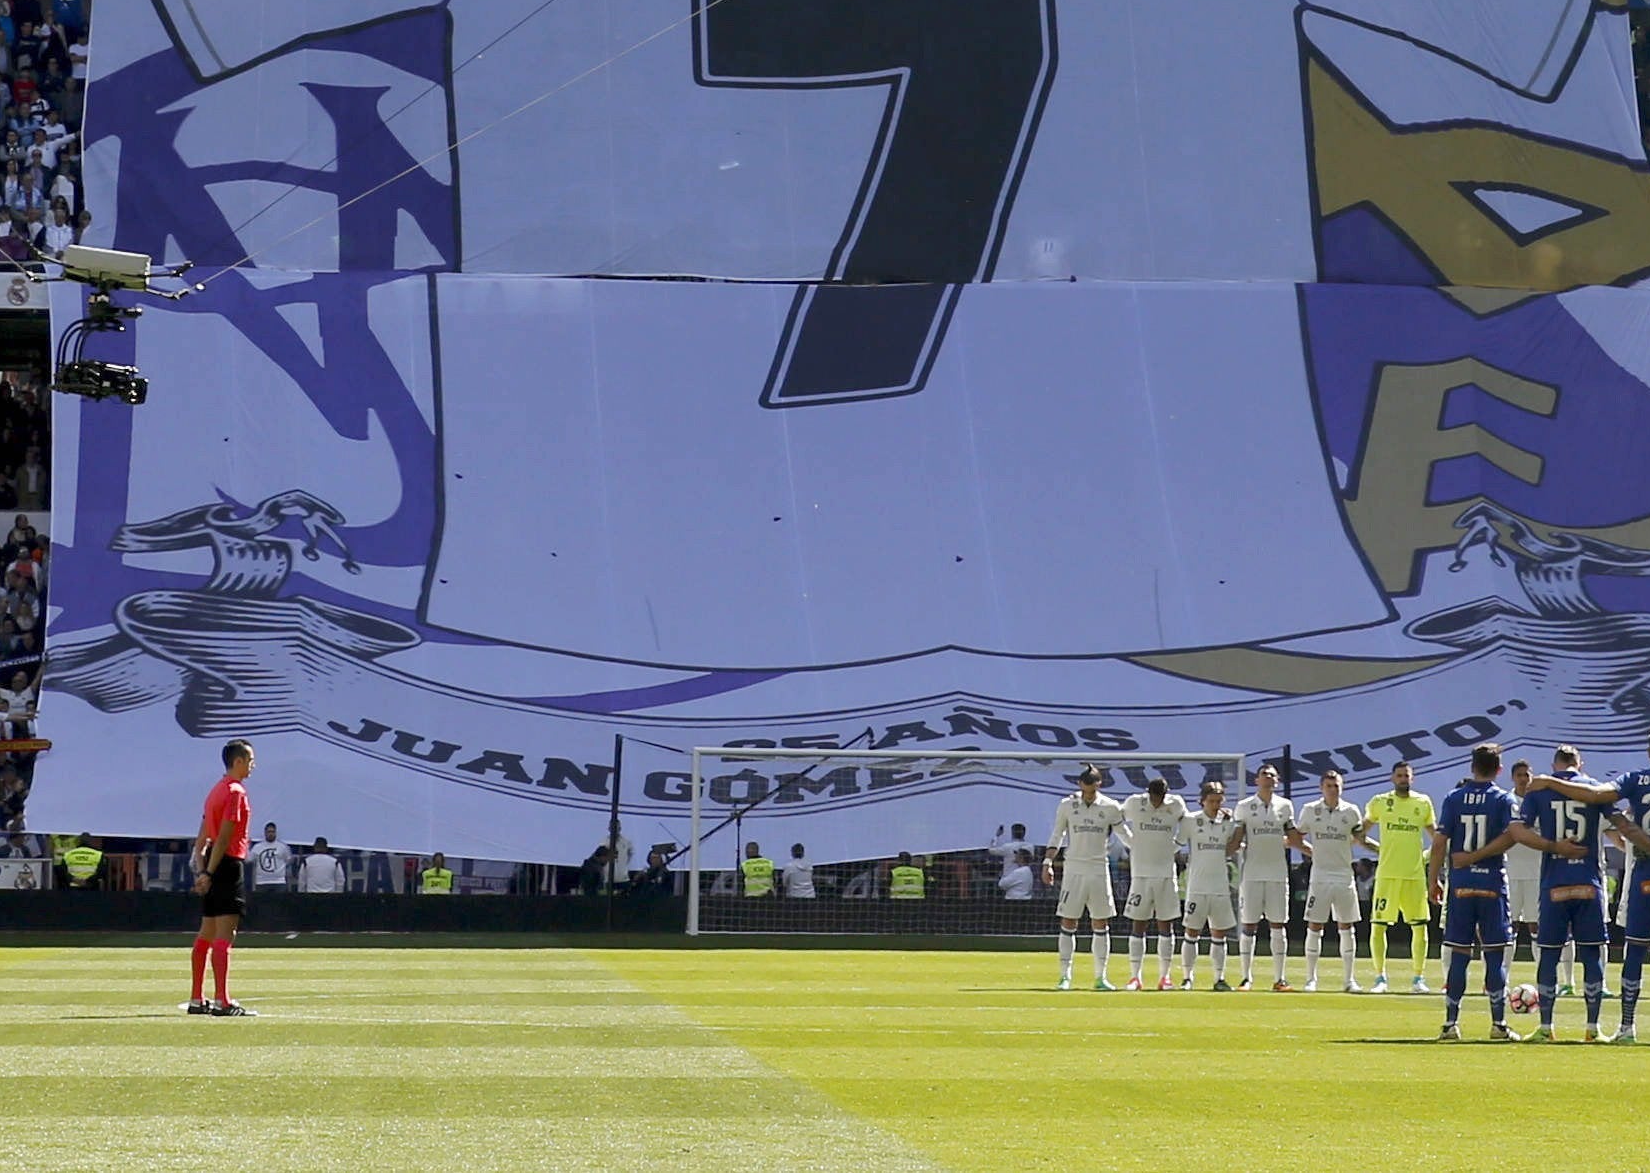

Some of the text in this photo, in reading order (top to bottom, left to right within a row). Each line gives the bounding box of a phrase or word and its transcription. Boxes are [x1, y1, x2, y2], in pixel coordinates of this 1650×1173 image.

[870, 705, 1141, 752] AÑOS
[327, 717, 617, 796] JUAN
[642, 746, 992, 806] GÓMEZ
[1463, 792, 1487, 804] IBAI
[1460, 814, 1487, 853] 11
[1551, 800, 1587, 843] 15
[1128, 893, 1142, 907] 23
[1307, 895, 1316, 909] 8
[1375, 897, 1388, 911] 13
